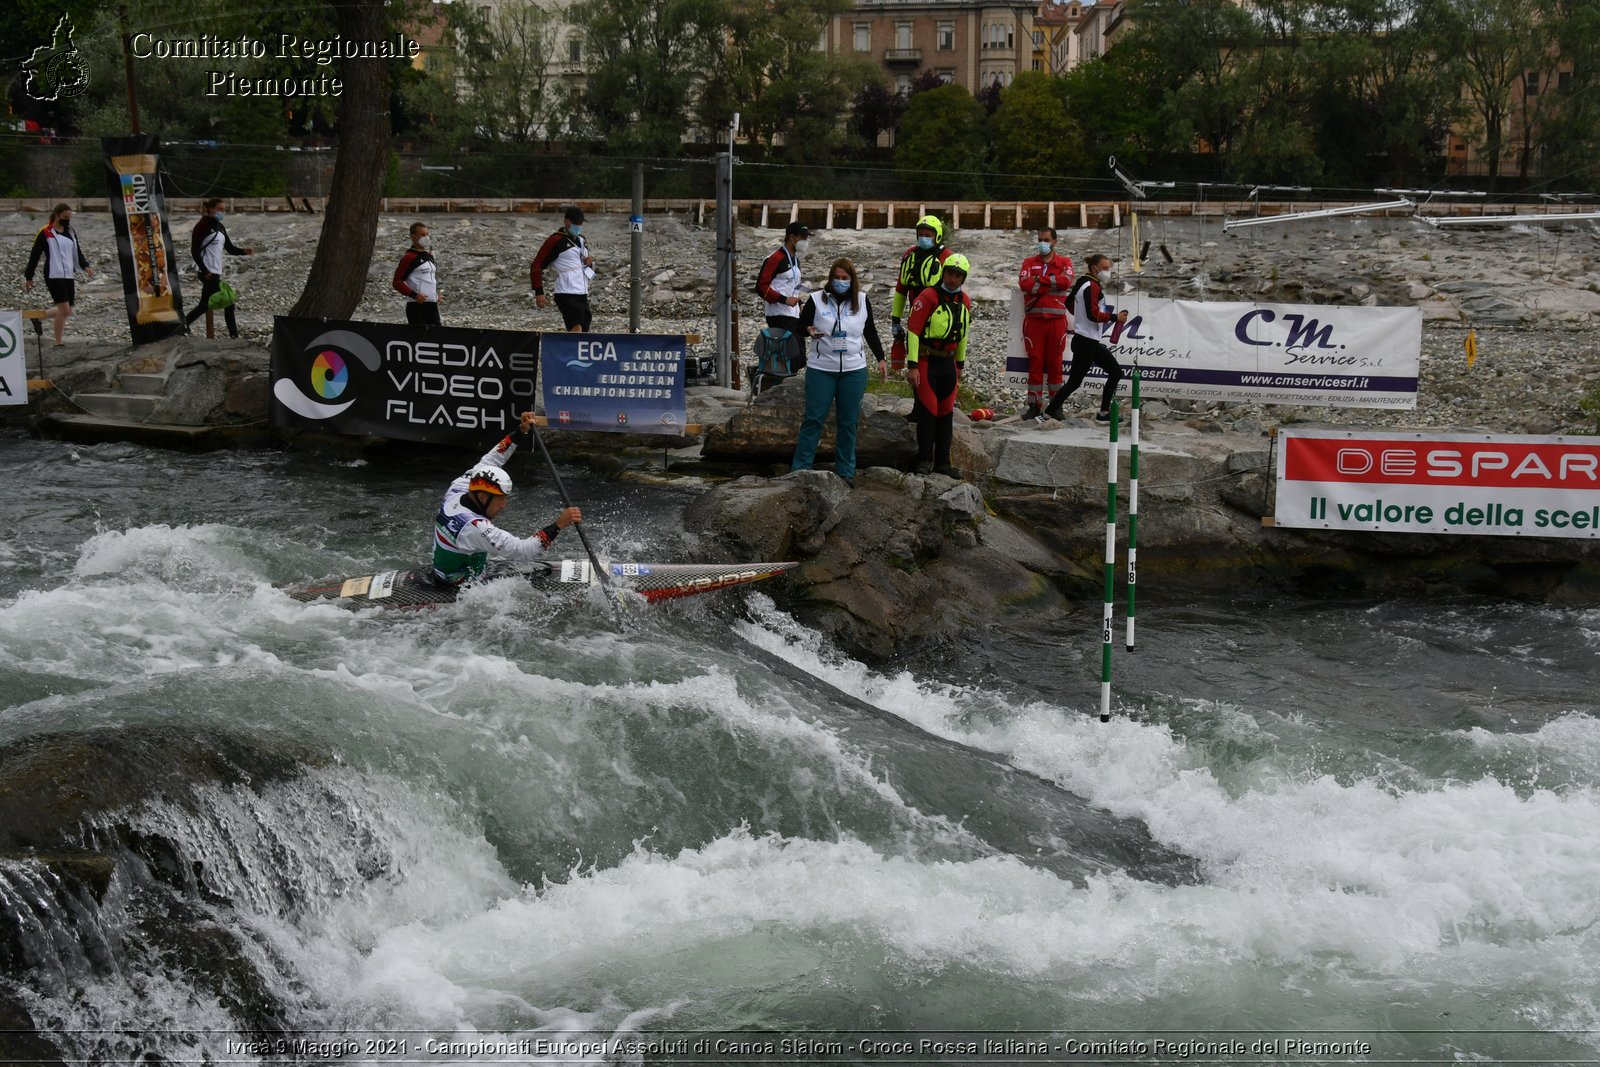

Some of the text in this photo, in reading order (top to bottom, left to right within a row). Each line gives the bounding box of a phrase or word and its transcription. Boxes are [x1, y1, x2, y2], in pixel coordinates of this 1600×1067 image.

[132, 173, 150, 214] KIND
[386, 340, 504, 370] MEDIA
[577, 341, 618, 361] ECA
[633, 350, 682, 361] CANOE
[1106, 341, 1167, 357] ervice
[1284, 345, 1358, 366] Service
[622, 362, 678, 373] SLALOM
[387, 369, 504, 400] VIDEO
[599, 374, 675, 386] EUROPEAN
[1240, 373, 1370, 389] www.cmservicesrl.it
[554, 386, 673, 399] CHAMPIONSHIPS
[1186, 388, 1222, 397] LOGISTICA
[1227, 390, 1263, 399] VIGILANZA
[1266, 392, 1325, 402] PROGETTAZIONE
[1360, 396, 1414, 405] MANUTENZIONE
[386, 399, 505, 431] FLASH
[1336, 448, 1599, 481] DESPAR
[1310, 496, 1327, 520] Il
[1337, 499, 1434, 524] valore
[1444, 502, 1524, 527] della
